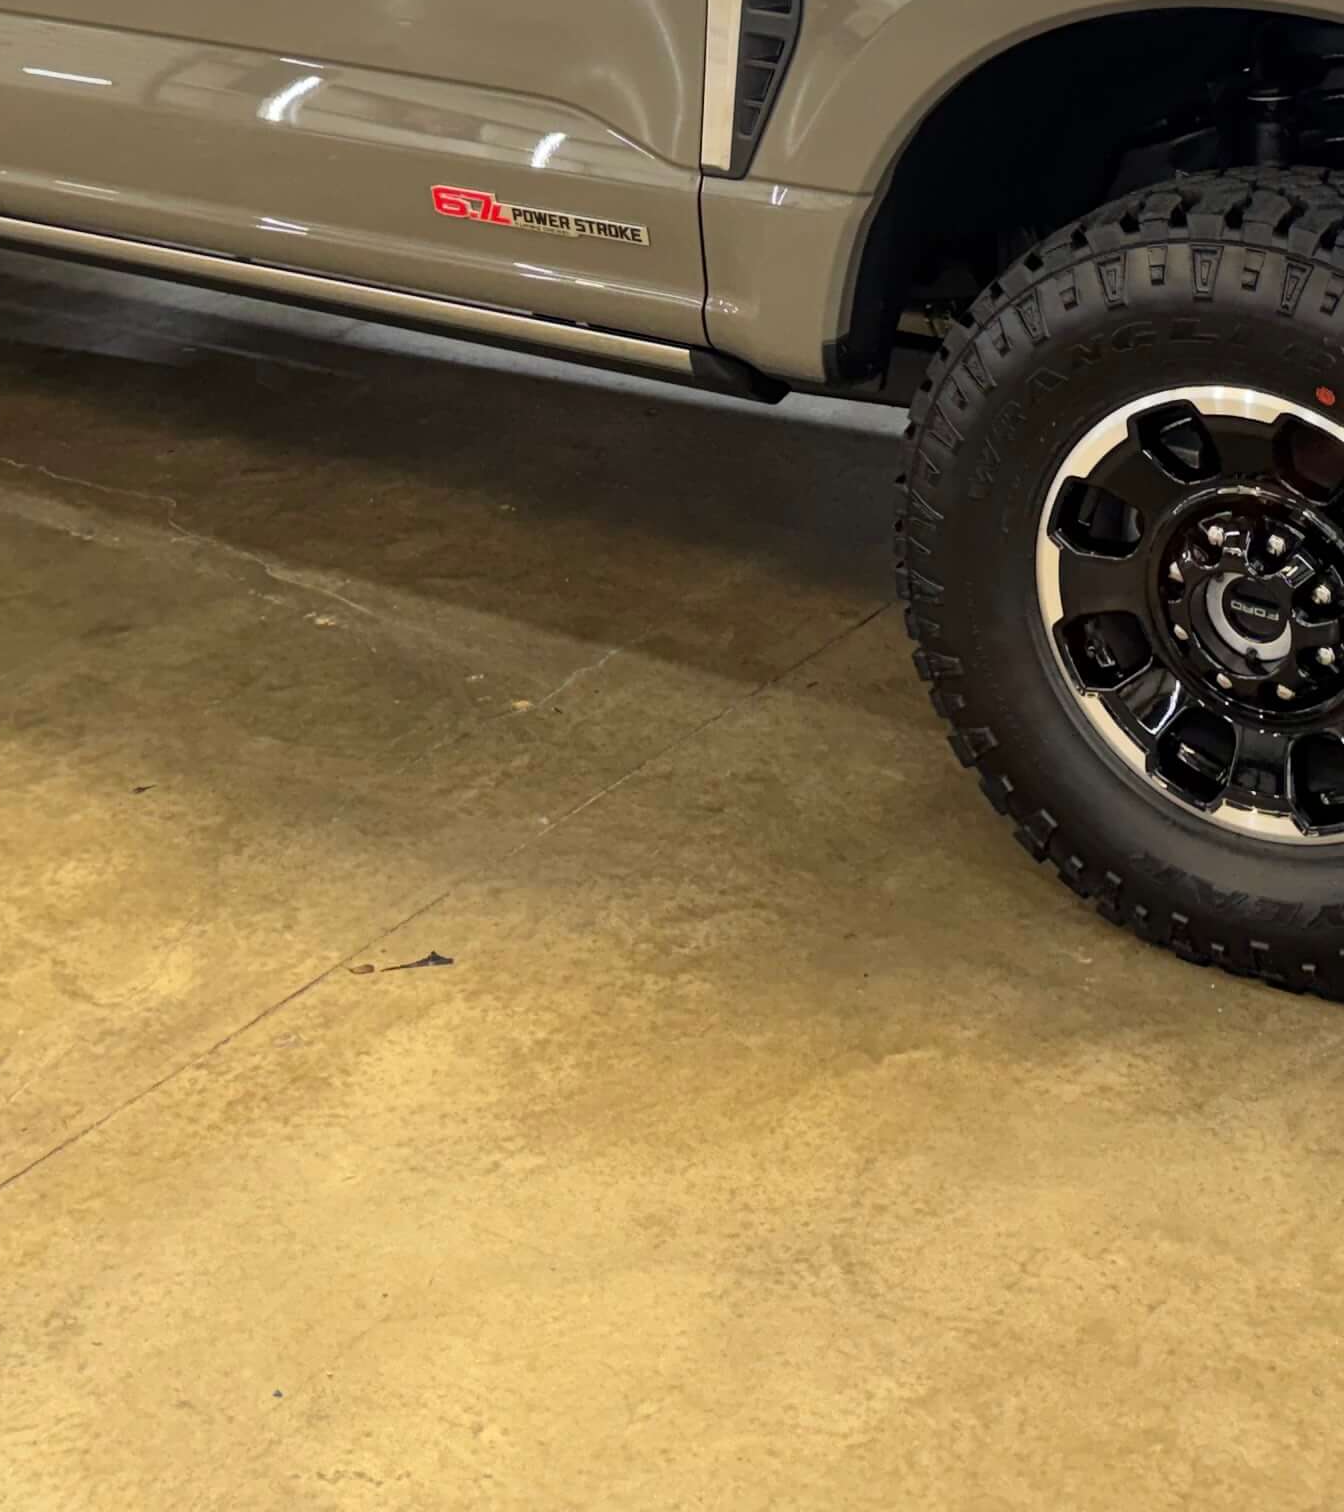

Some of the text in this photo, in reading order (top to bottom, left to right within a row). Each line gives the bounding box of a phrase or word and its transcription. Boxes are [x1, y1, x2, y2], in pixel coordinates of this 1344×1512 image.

[432, 186, 512, 225] 6.7L
[512, 207, 571, 230] POWER
[574, 218, 643, 243] STROKE
[1230, 599, 1280, 621] FORD
